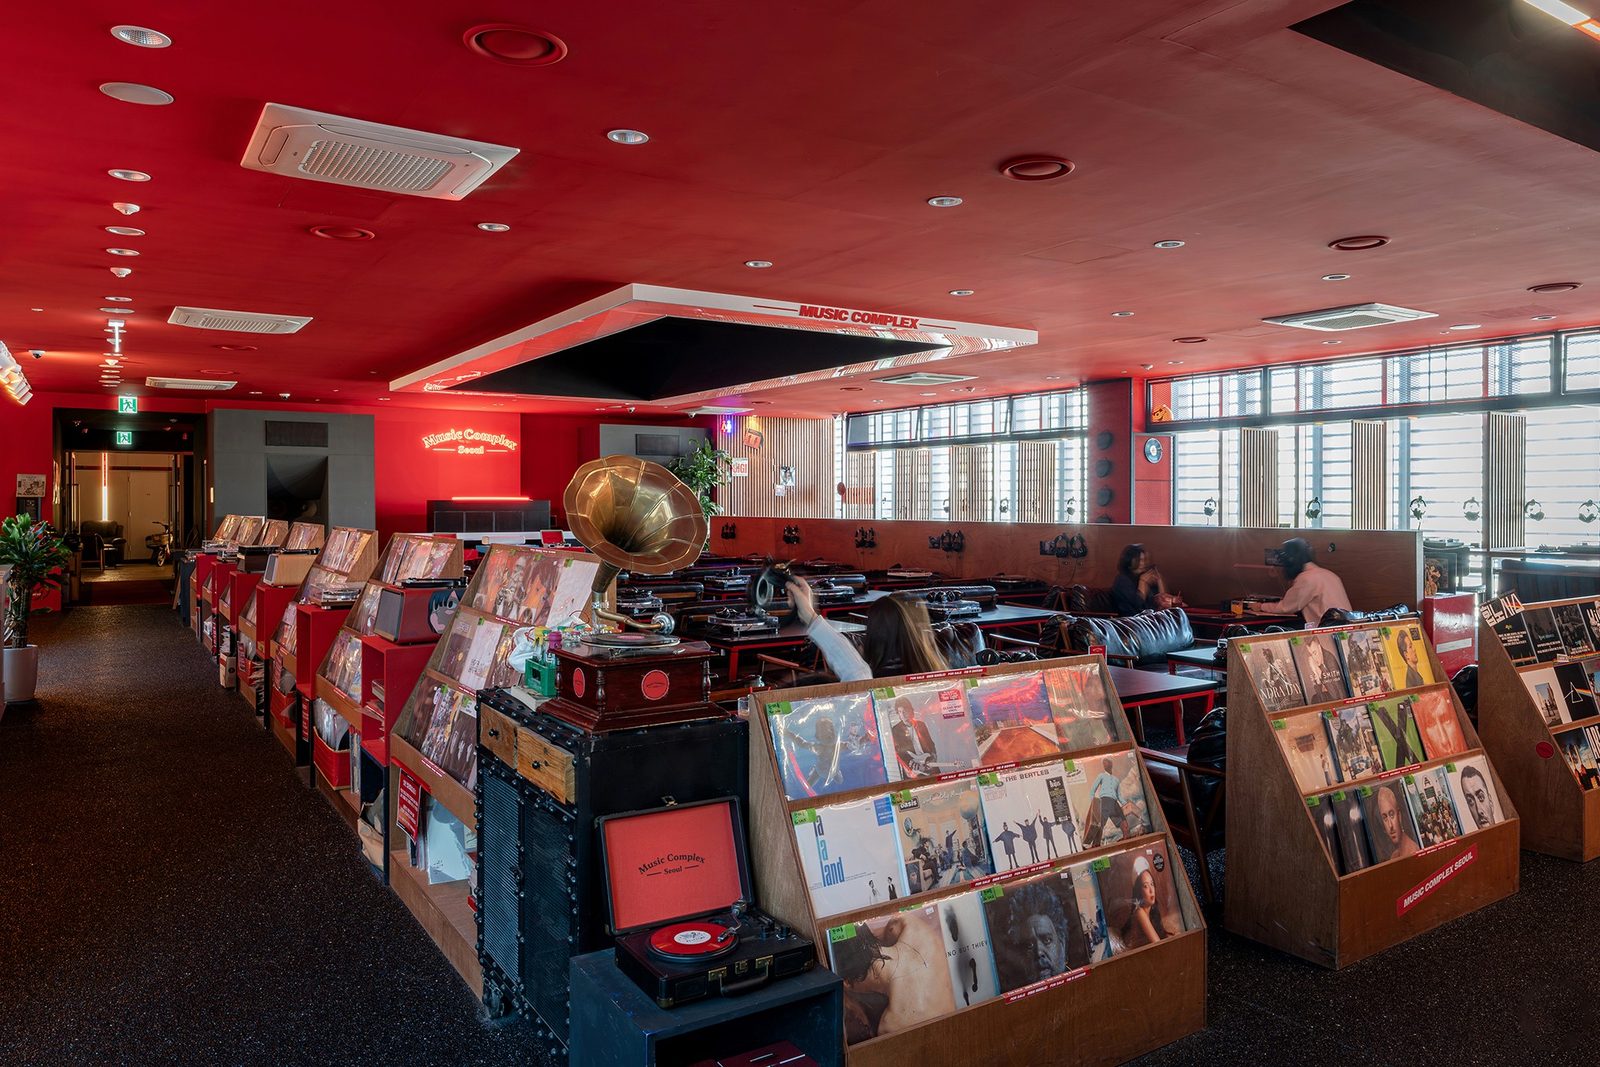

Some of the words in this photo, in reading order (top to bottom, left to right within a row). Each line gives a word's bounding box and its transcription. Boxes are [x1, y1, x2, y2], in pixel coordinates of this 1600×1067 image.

[799, 304, 849, 321] MUSIC
[851, 311, 920, 330] COMPLEX
[422, 428, 463, 449] Music
[463, 428, 518, 451] Complex
[457, 445, 485, 455] Seoul
[1005, 774, 1018, 782] THE
[1019, 769, 1050, 780] BEATLES
[900, 799, 918, 810] oasis
[638, 856, 666, 875] Music
[666, 852, 706, 864] Complex
[663, 866, 683, 875] Seoul
[820, 856, 846, 888] land
[1403, 886, 1426, 909] MUSIC
[1424, 864, 1455, 893] COMPLEX
[1453, 850, 1474, 872] SEOUL
